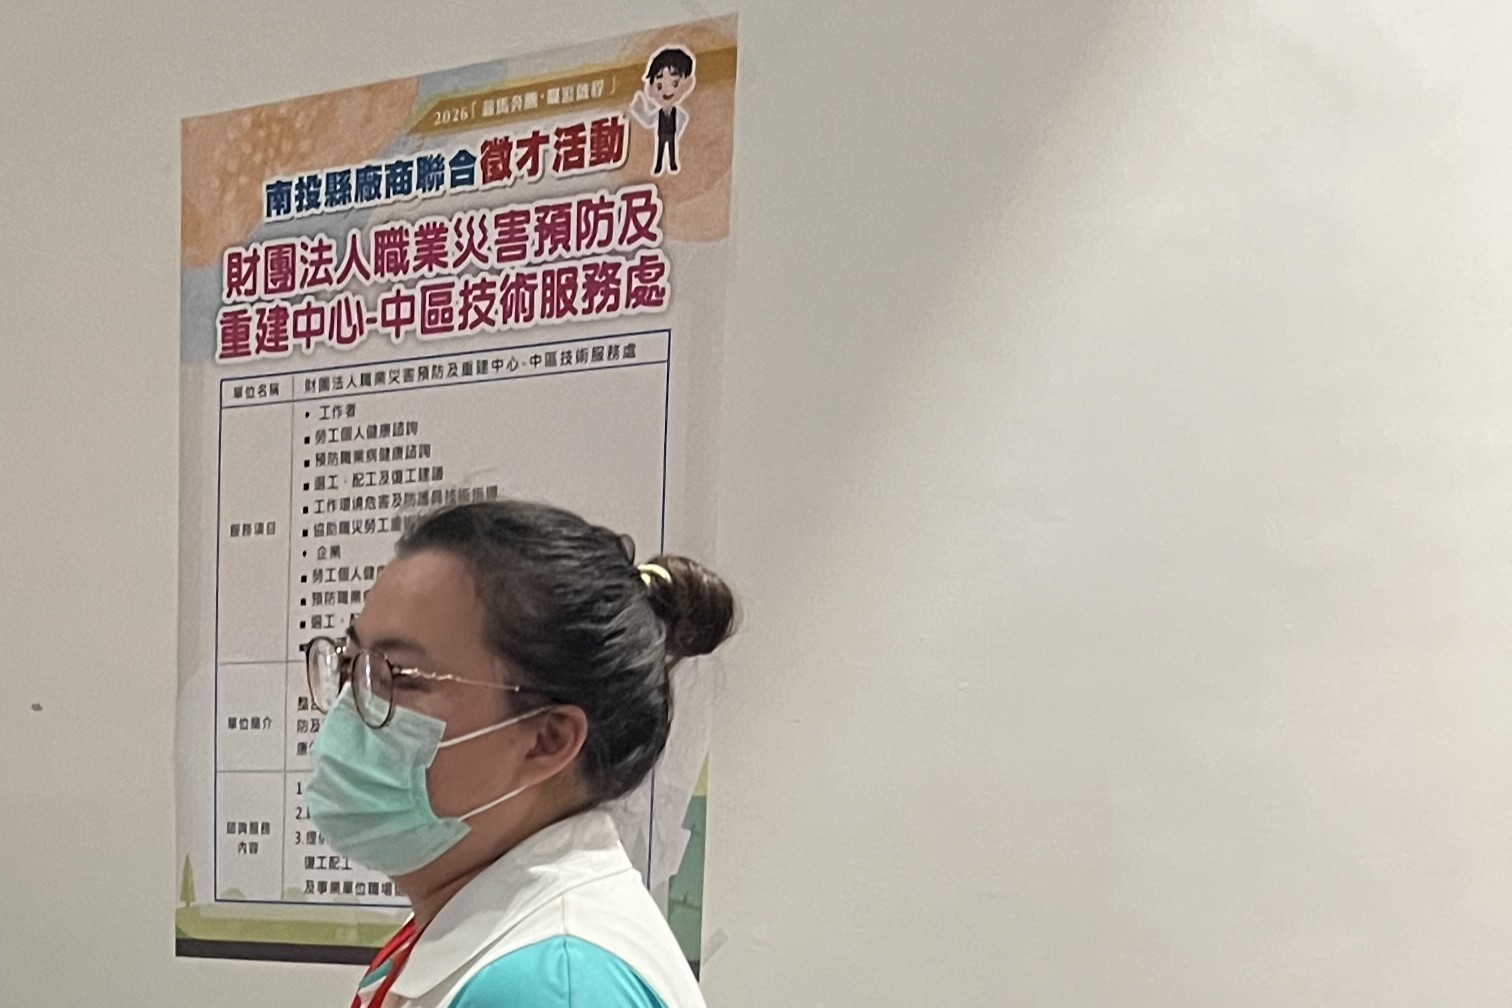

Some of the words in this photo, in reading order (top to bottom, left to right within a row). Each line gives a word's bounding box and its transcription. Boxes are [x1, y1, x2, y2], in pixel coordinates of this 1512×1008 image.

[265, 115, 626, 218] 南投縣廠商聯合徵才活動
[226, 189, 662, 298] 財團法人職業災害預防及
[218, 256, 666, 359] 重建中心-中區技術服務處
[304, 343, 637, 394] 財團法人職業災害預防及重建中心-中區技術服務處
[232, 383, 280, 399] 單位名稱
[318, 404, 357, 420] 工作者
[311, 590, 370, 606] 預防職業
[303, 880, 401, 896] 及事業單位職場
